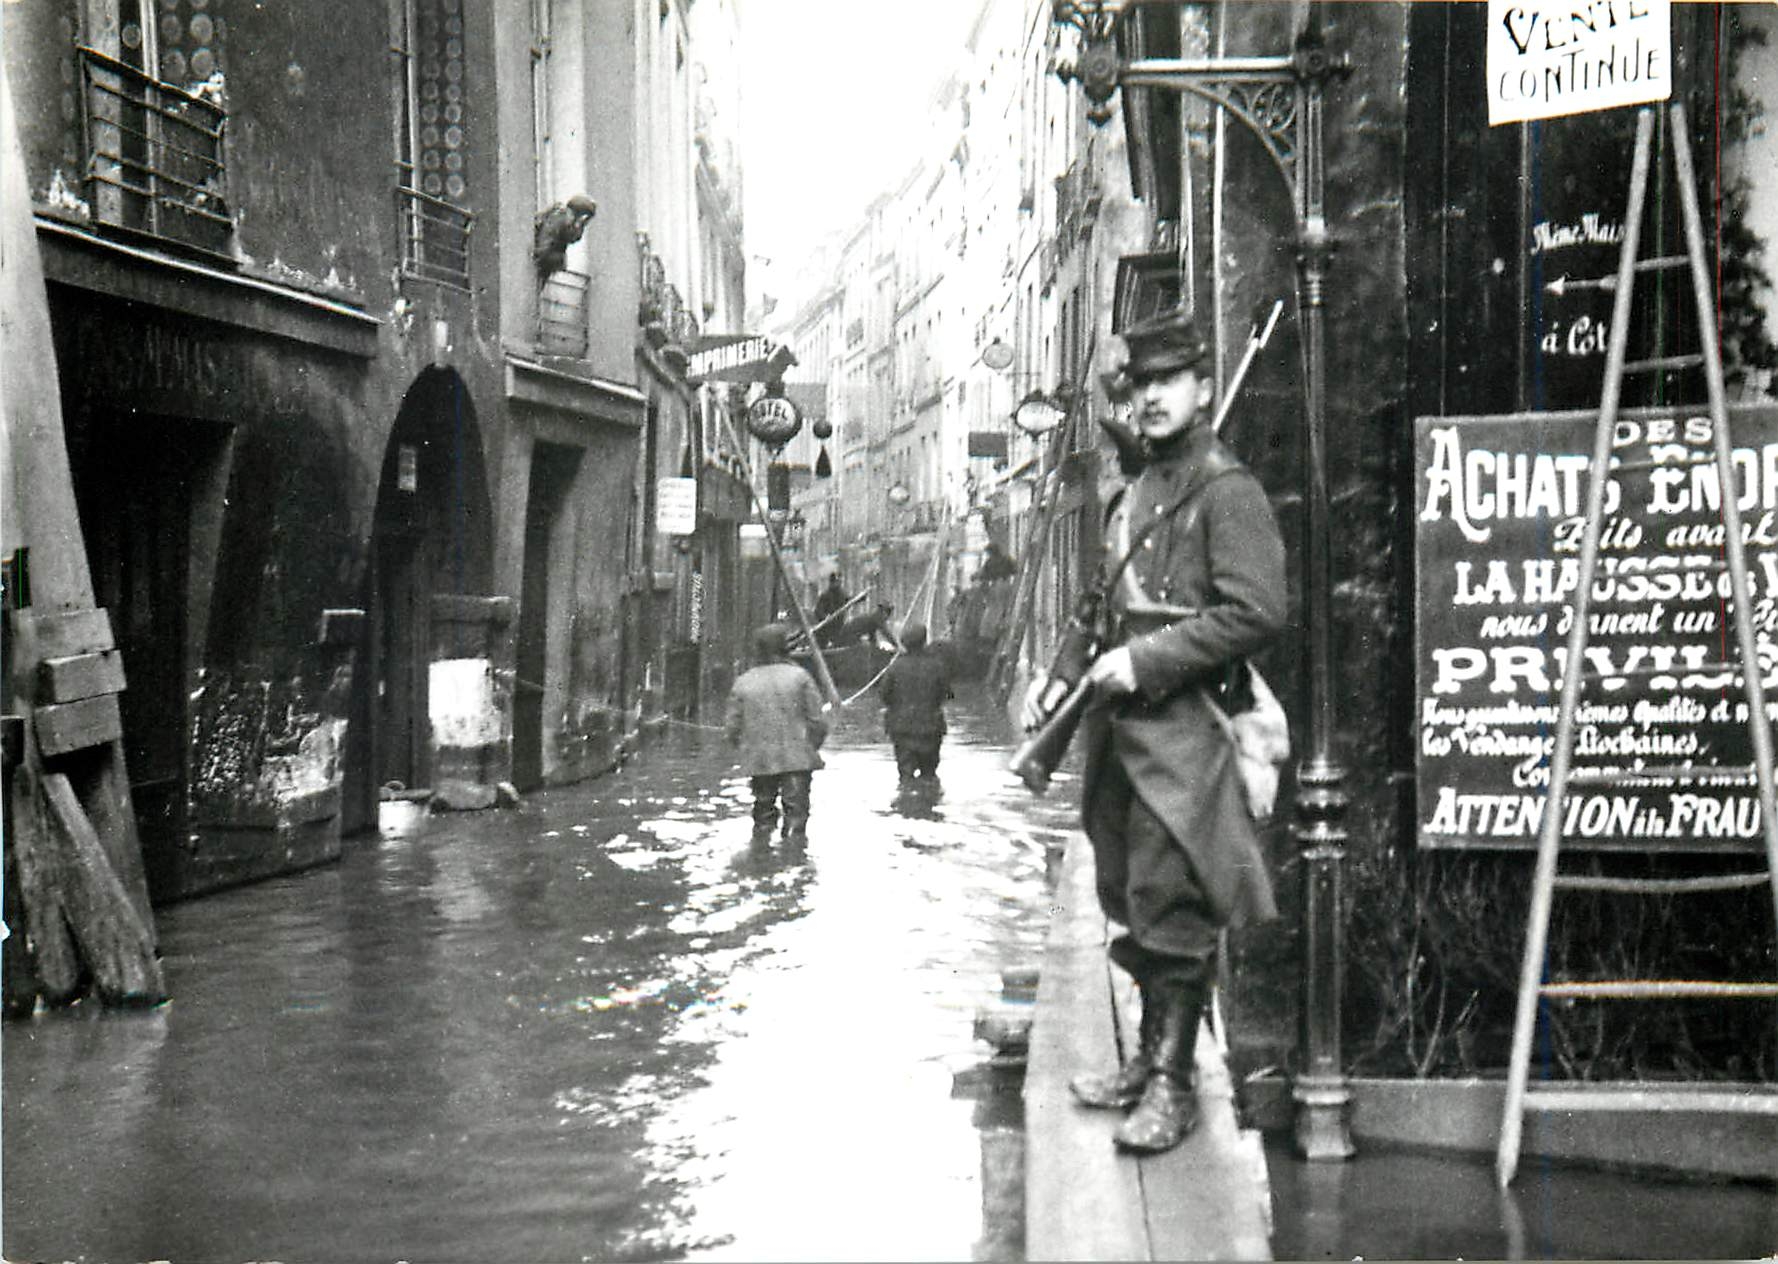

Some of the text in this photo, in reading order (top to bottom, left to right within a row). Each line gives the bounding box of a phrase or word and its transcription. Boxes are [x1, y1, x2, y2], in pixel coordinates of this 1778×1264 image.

[1500, 38, 1660, 103] CONTINUE
[1613, 417, 1713, 447] DES
[1453, 562, 1516, 604] LA
[1480, 612, 1548, 638] nous
[1673, 611, 1716, 633] un
[1423, 787, 1638, 837] ATTENION
[1665, 793, 1761, 838] FRAU
